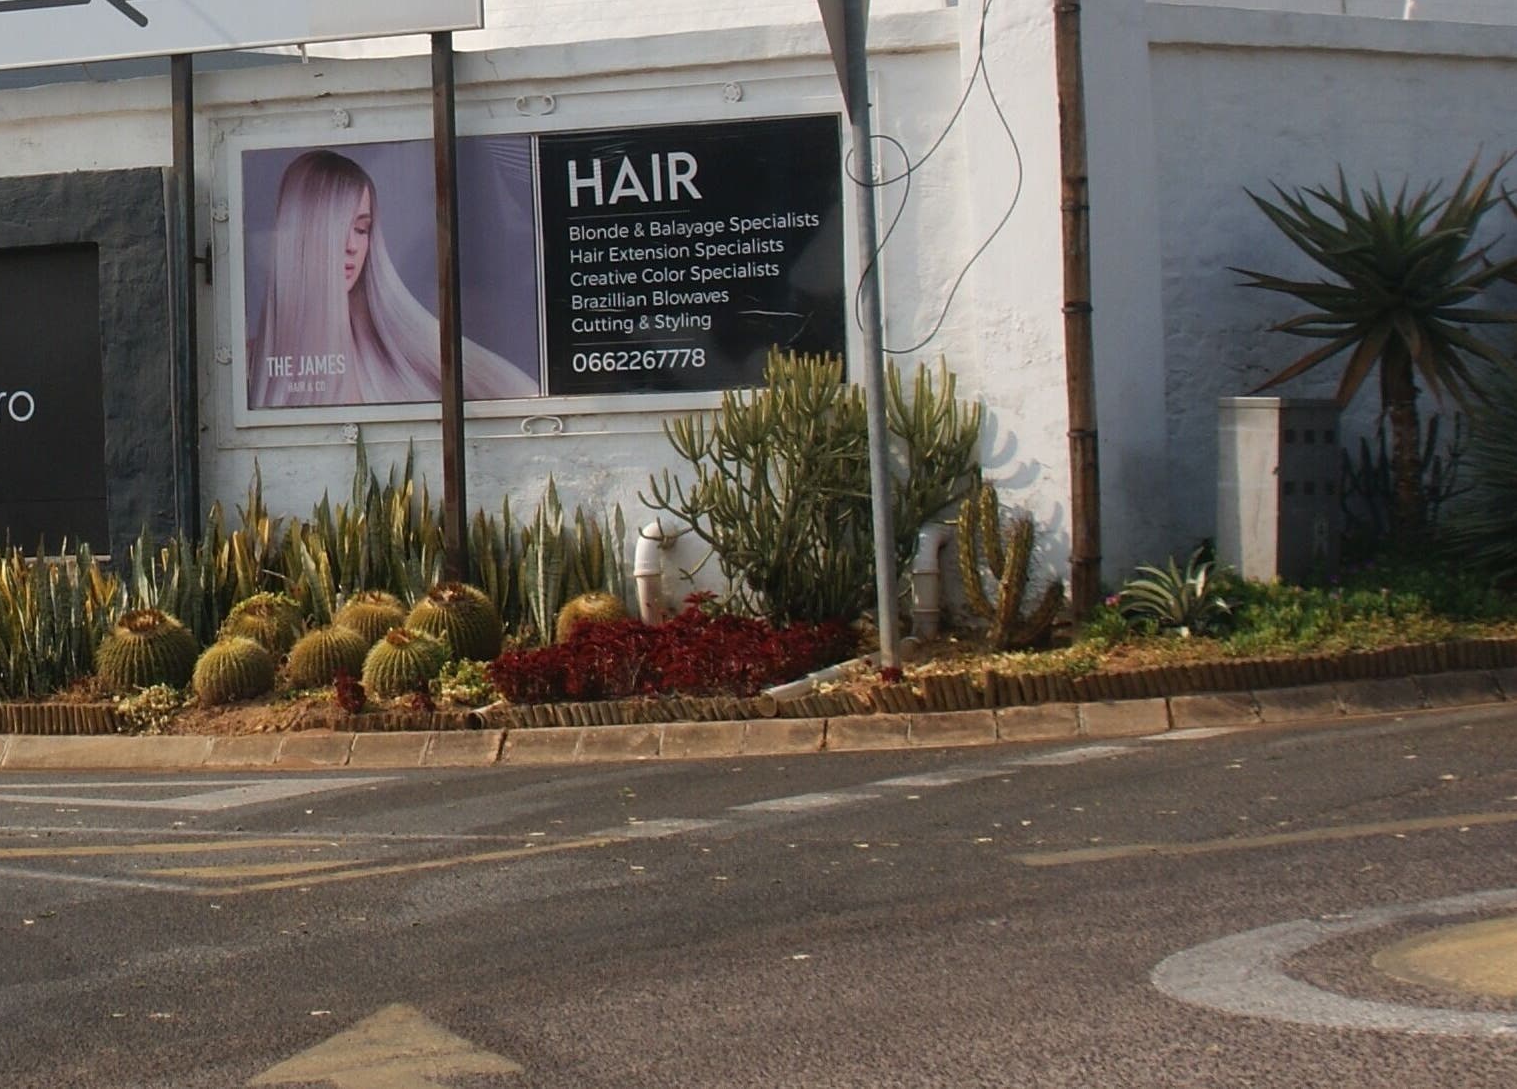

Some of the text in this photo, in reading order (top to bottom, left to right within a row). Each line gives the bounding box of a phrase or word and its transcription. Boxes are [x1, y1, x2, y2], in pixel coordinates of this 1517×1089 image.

[567, 151, 703, 208] HAIR
[569, 212, 820, 241] Blonde & Balayage Specialists
[570, 237, 784, 264] Hair Extension Specialists
[570, 261, 780, 287] Creative Color Specialists
[571, 288, 729, 310] Brazillian Blowaves
[571, 311, 712, 334] Cutting & Styling
[266, 354, 347, 377] THE JAMES
[572, 347, 707, 373] 0662267778
